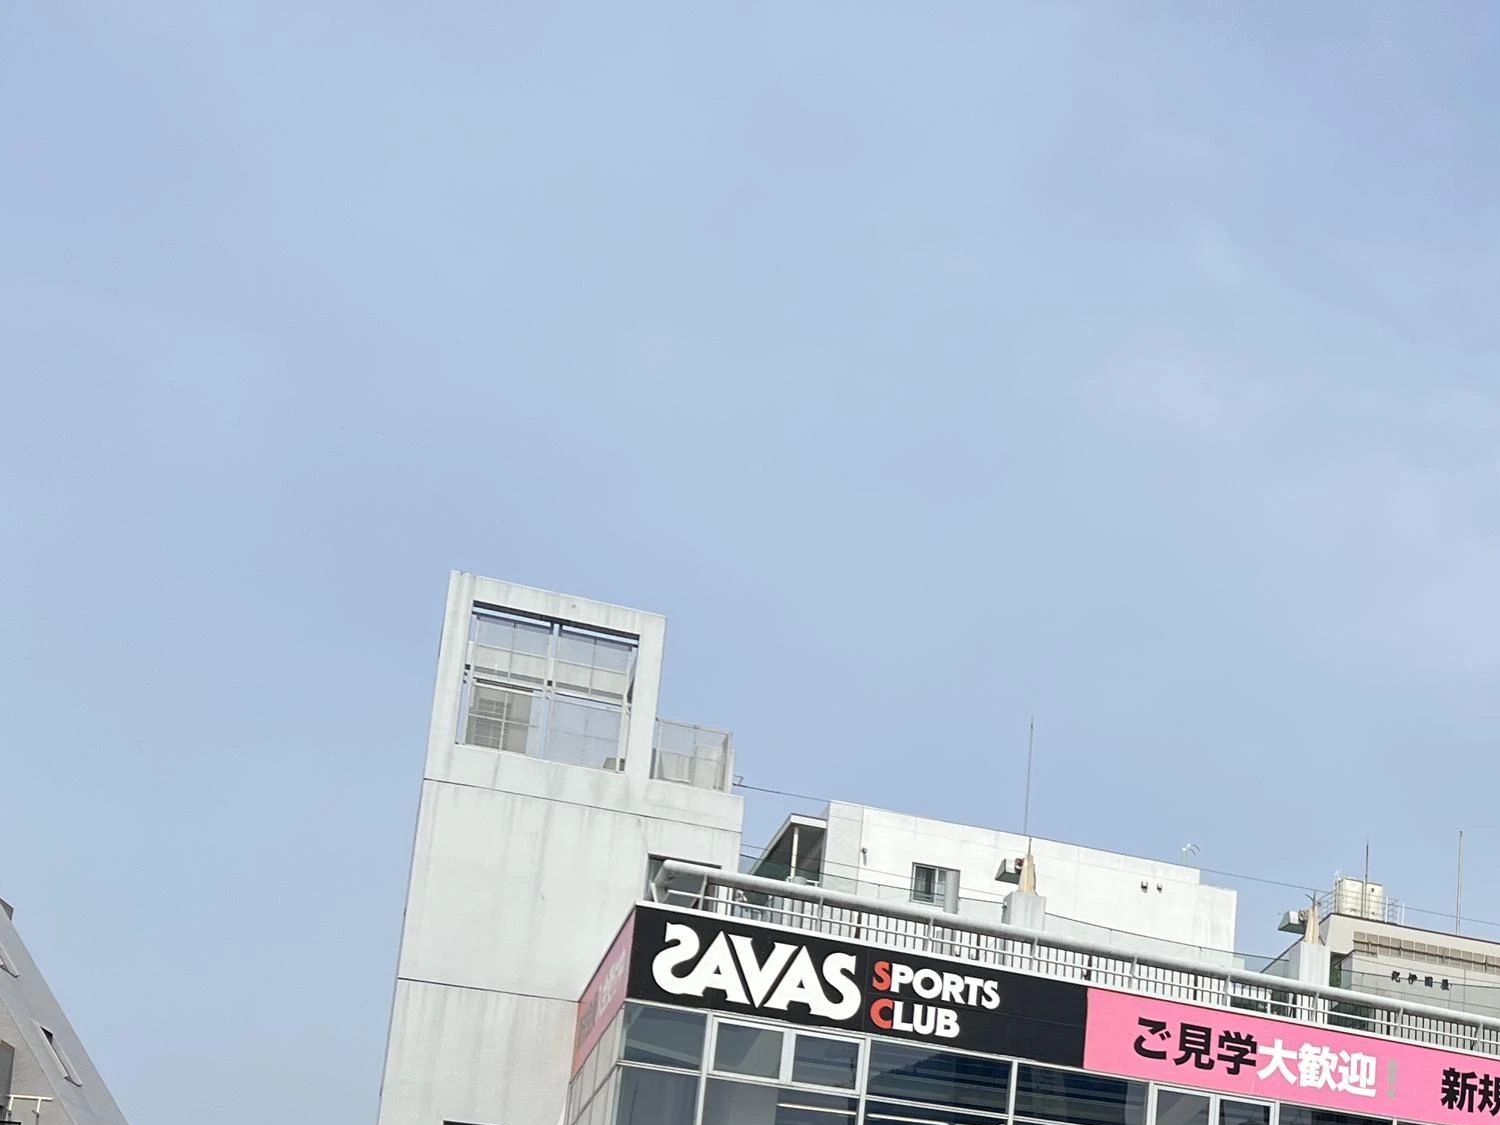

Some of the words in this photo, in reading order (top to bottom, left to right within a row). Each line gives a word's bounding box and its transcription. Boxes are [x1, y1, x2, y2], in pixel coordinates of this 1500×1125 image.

[652, 922, 861, 1021] SAVAS
[872, 960, 1001, 1010] SPORTS
[869, 997, 961, 1039] CLUB
